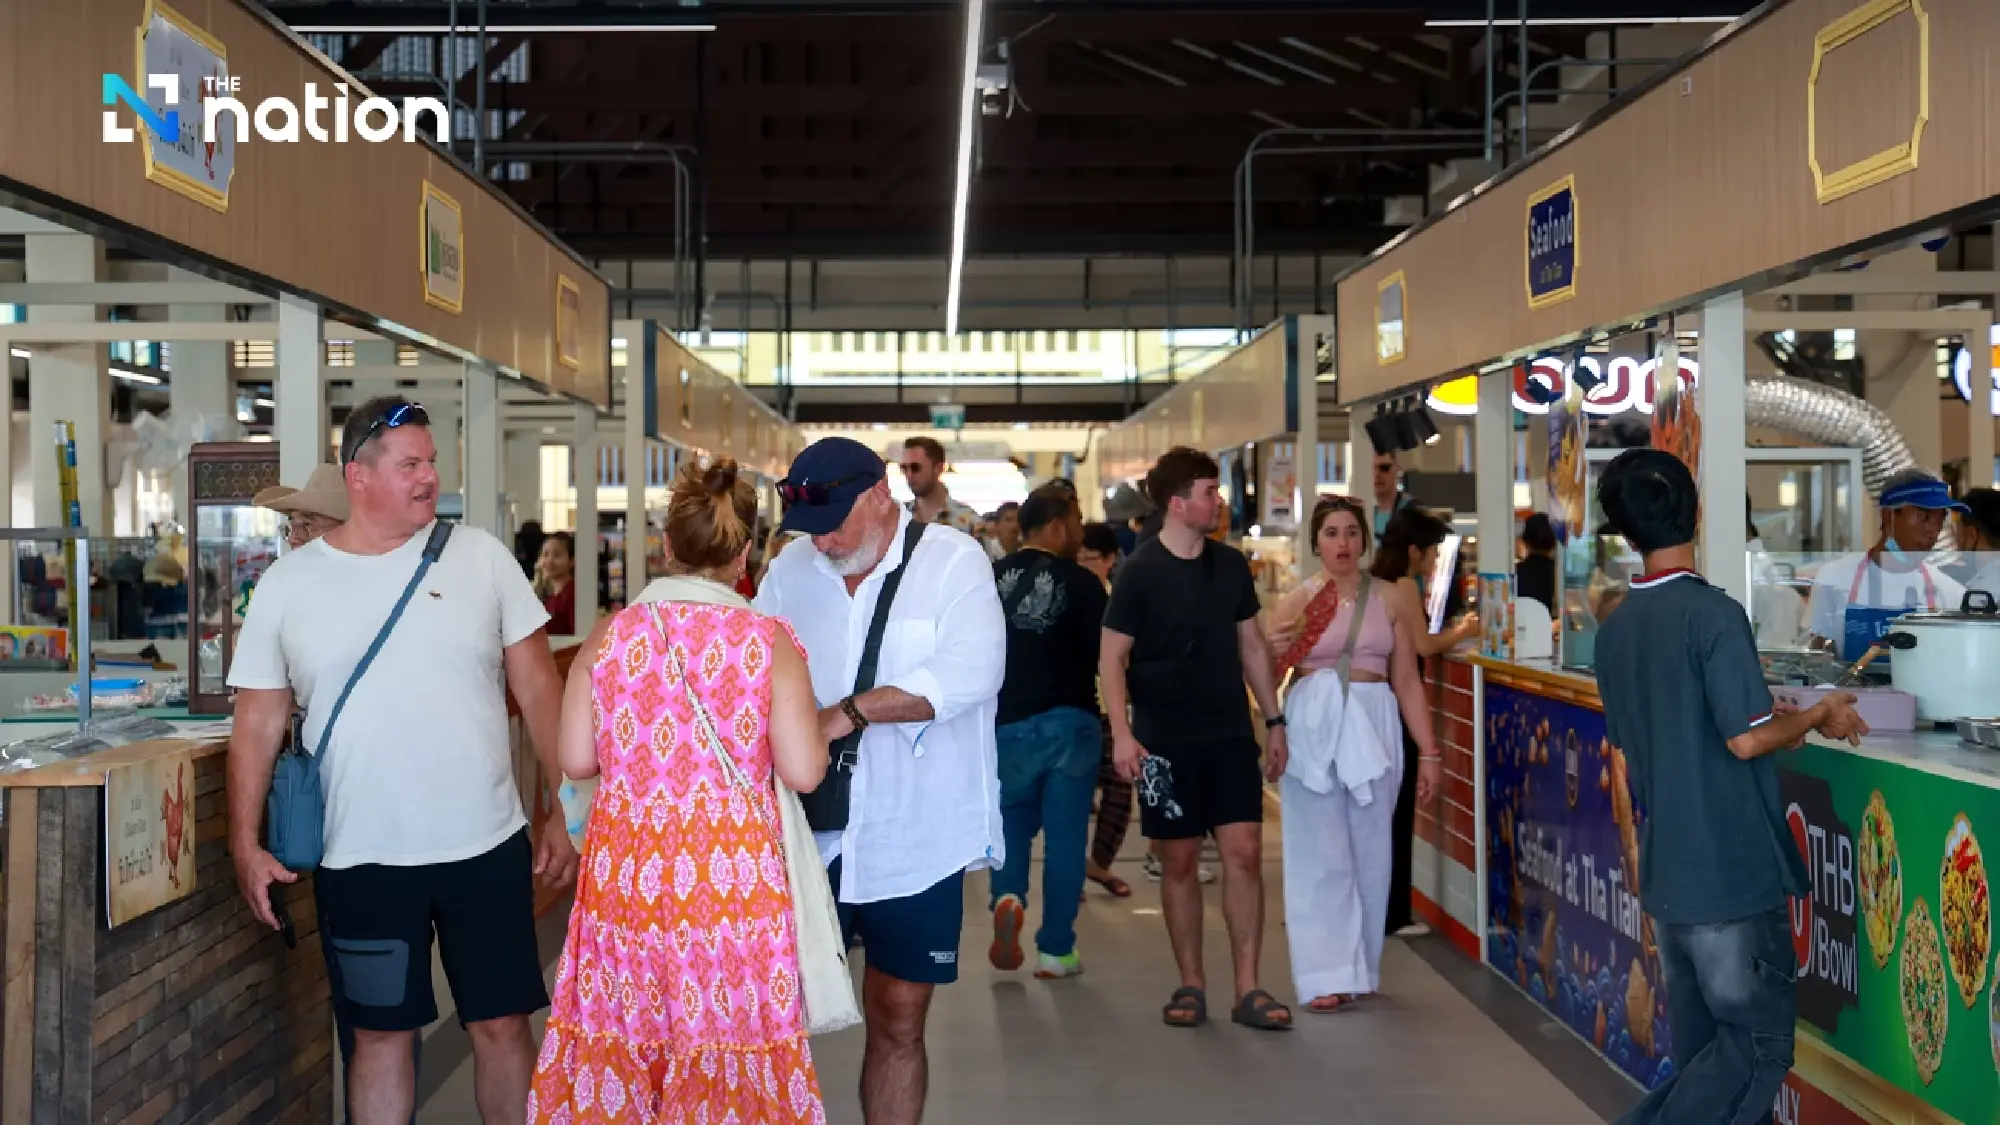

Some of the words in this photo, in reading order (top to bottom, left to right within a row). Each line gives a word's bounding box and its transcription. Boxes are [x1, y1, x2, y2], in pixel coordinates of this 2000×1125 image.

[1531, 198, 1573, 259] Seafood
[1518, 822, 1563, 897] Seafood
[1565, 853, 1579, 906] at
[1582, 853, 1608, 922] Tha
[1608, 868, 1641, 942] Tian
[1809, 824, 1855, 917] THB
[1811, 916, 1858, 995] /Bowl
[1773, 1082, 1801, 1125] AILY
